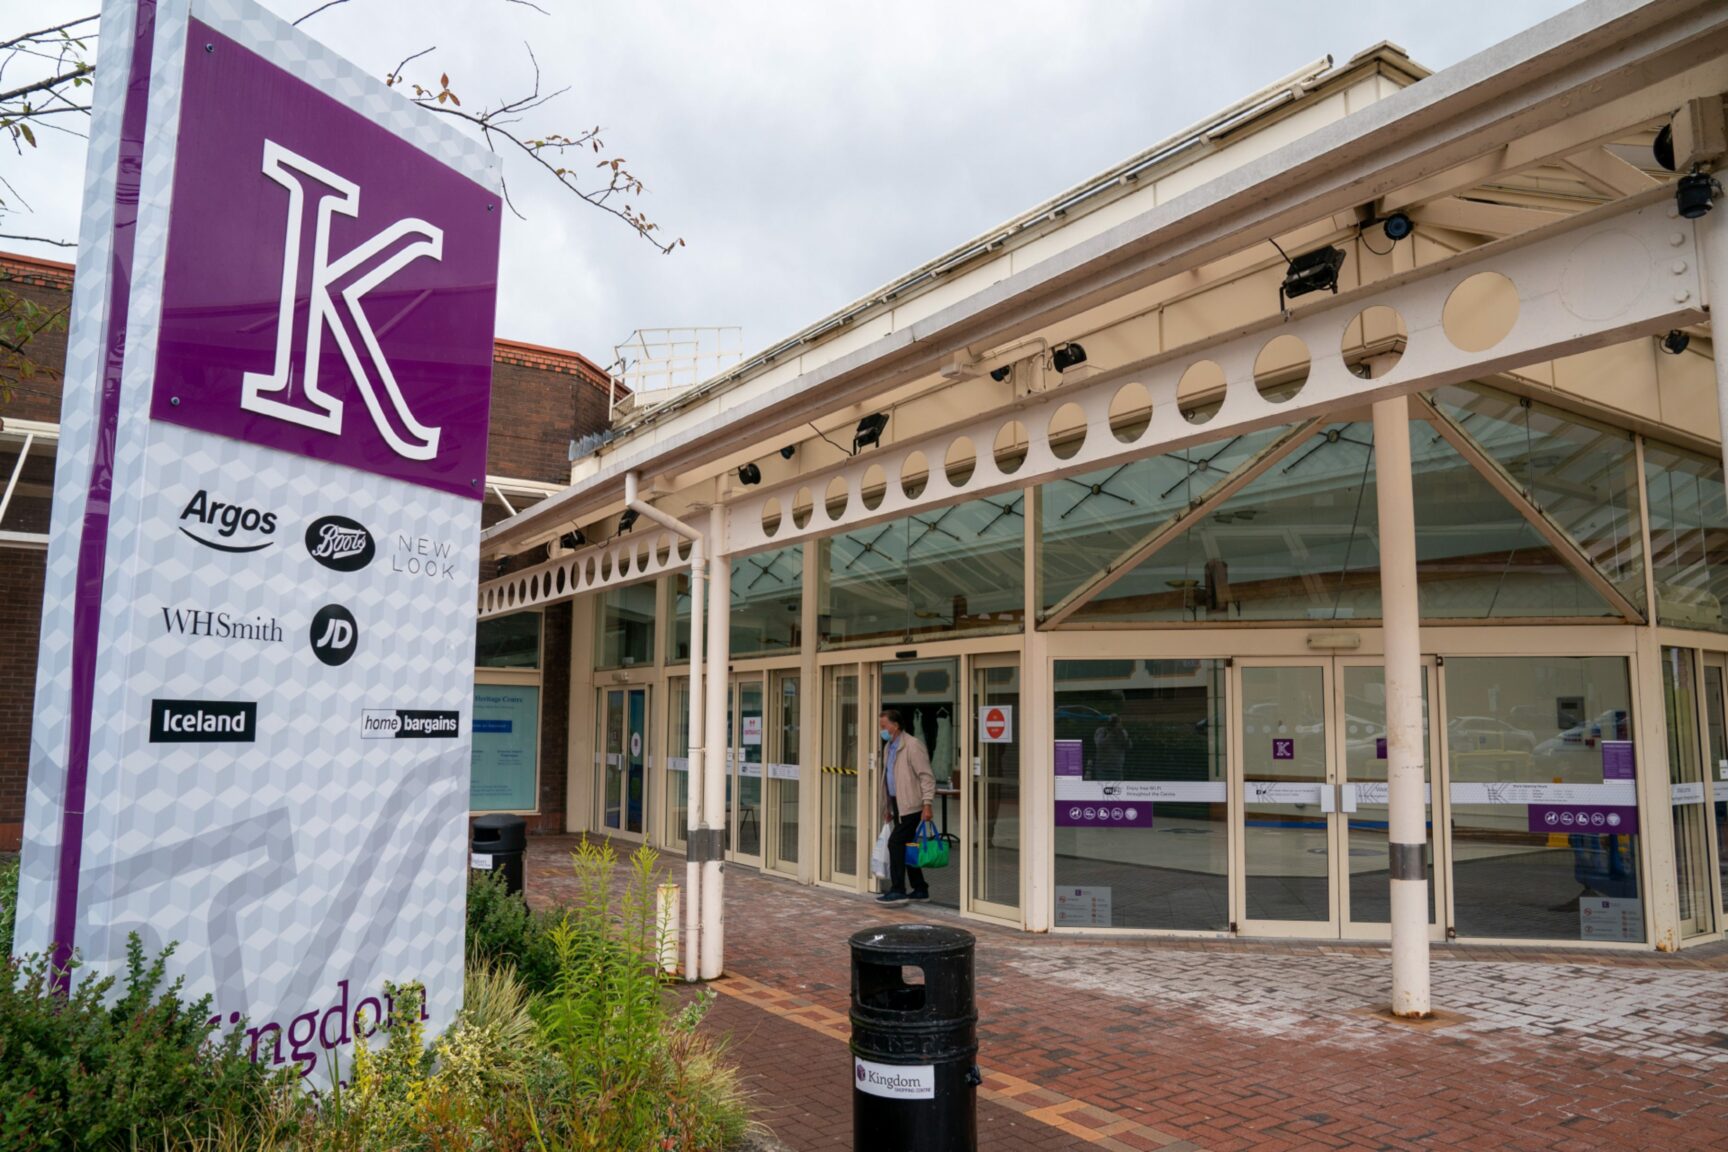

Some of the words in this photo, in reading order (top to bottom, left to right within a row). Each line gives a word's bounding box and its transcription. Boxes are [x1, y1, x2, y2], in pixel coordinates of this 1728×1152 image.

[240, 138, 444, 461] K
[179, 489, 278, 537] Argos
[311, 522, 367, 561] Boots
[398, 534, 452, 559] NEW
[392, 557, 455, 581] LOOK
[161, 606, 284, 643] WHSmith
[316, 617, 354, 650] JD
[163, 709, 246, 734] Iceland
[364, 715, 399, 732] home
[403, 715, 457, 734] bargains
[1276, 741, 1291, 756] K
[868, 1070, 921, 1089] Kingdom
